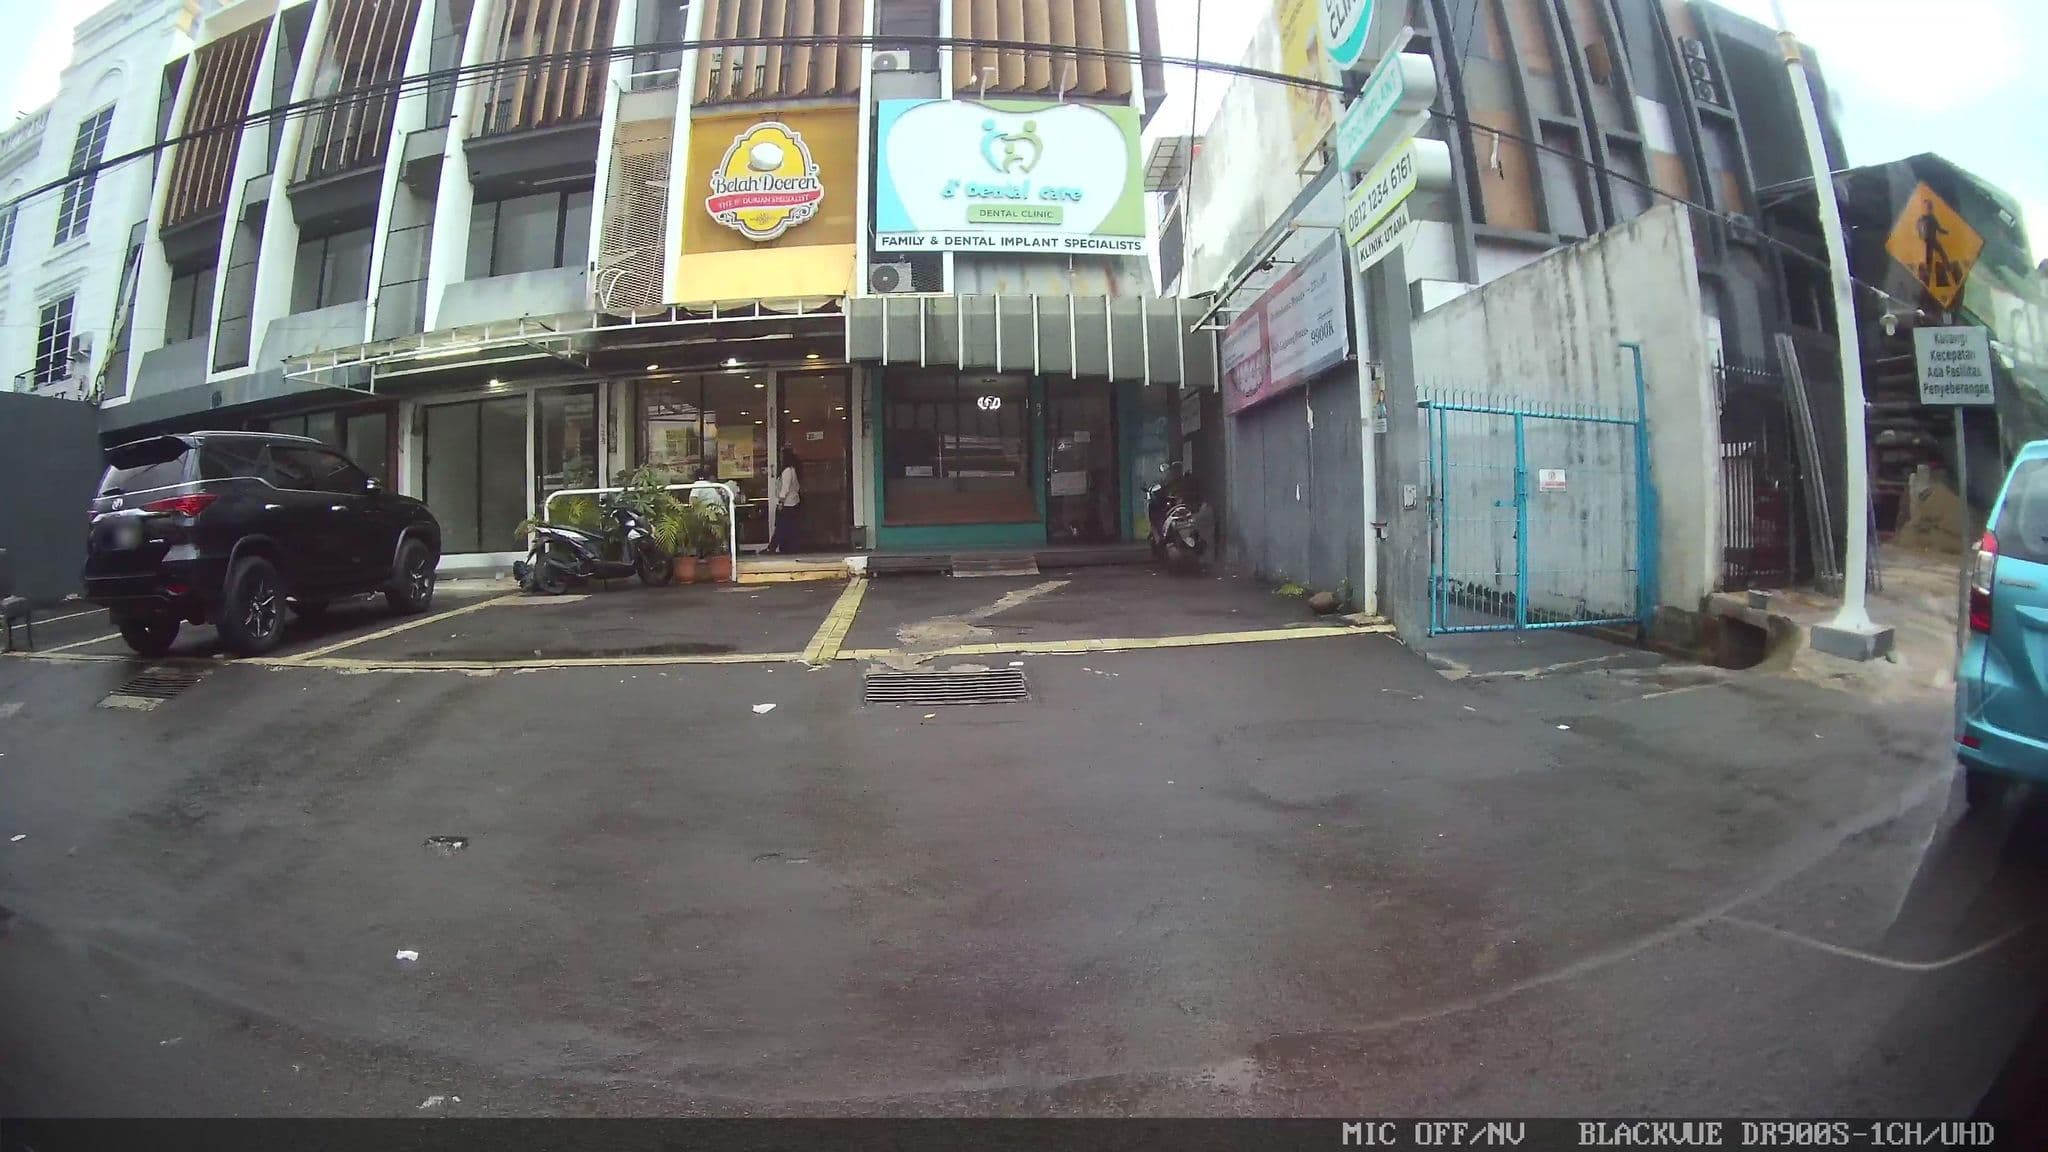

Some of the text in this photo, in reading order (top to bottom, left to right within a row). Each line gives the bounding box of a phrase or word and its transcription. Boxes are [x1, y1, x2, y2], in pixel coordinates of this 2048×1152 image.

[716, 174, 817, 194] Belah Doeren
[1039, 185, 1083, 201] care
[1348, 152, 1412, 233] 0812 1234 6161
[979, 208, 1055, 219] DENTAL CLINIC
[881, 236, 1142, 251] FAMILY & DENTAL IMPLANT SPECIALISTS
[1360, 213, 1408, 263] KLINIK UTAMA
[1930, 349, 1976, 364] Kecepatan
[1928, 366, 1944, 378] Ada
[1923, 381, 1990, 398] Penyeberangan
